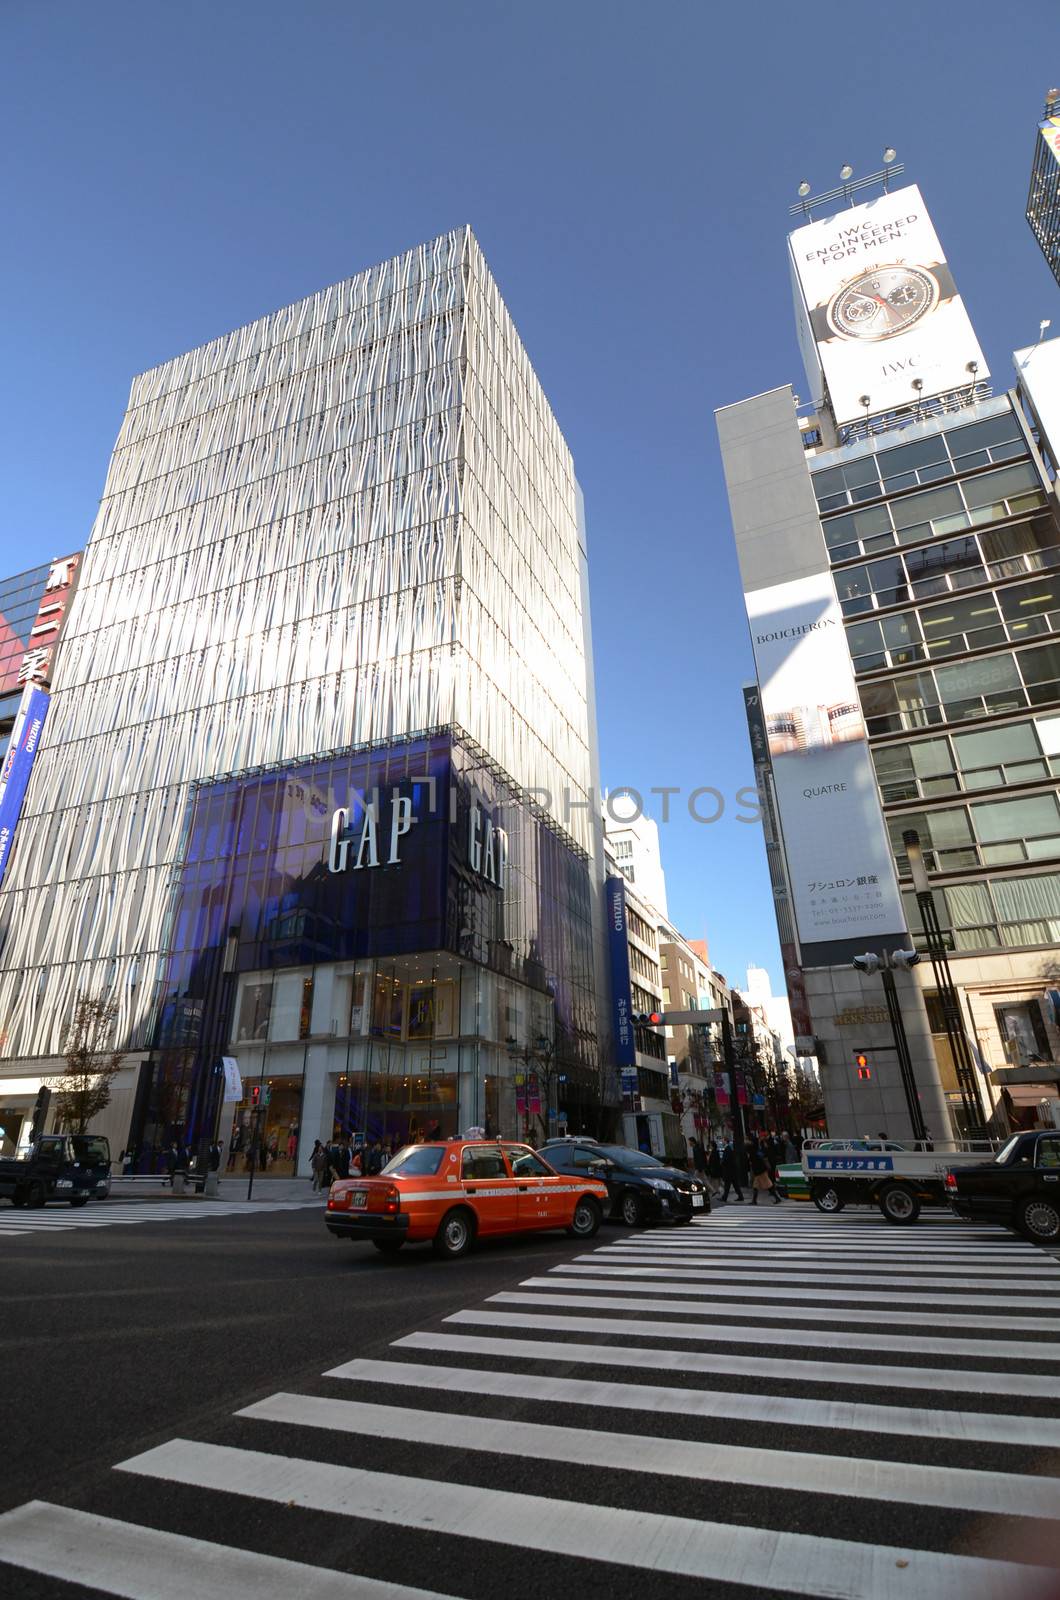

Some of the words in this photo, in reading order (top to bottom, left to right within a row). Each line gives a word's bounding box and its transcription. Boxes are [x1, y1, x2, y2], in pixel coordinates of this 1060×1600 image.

[806, 215, 918, 261] ENGINEERED
[822, 247, 857, 265] FOR
[864, 230, 907, 250] MEN.
[838, 221, 878, 240] IWC.
[882, 354, 921, 376] IWC
[756, 619, 836, 644] BOUCHERON
[26, 718, 42, 753] MIZUHO
[803, 783, 847, 798] QUATRE
[328, 796, 412, 873] GAP
[469, 805, 509, 890] GAP
[807, 875, 880, 892] ブシュロン銀座
[613, 892, 623, 931] MIZUHO
[617, 998, 629, 1045] みずほ銀行
